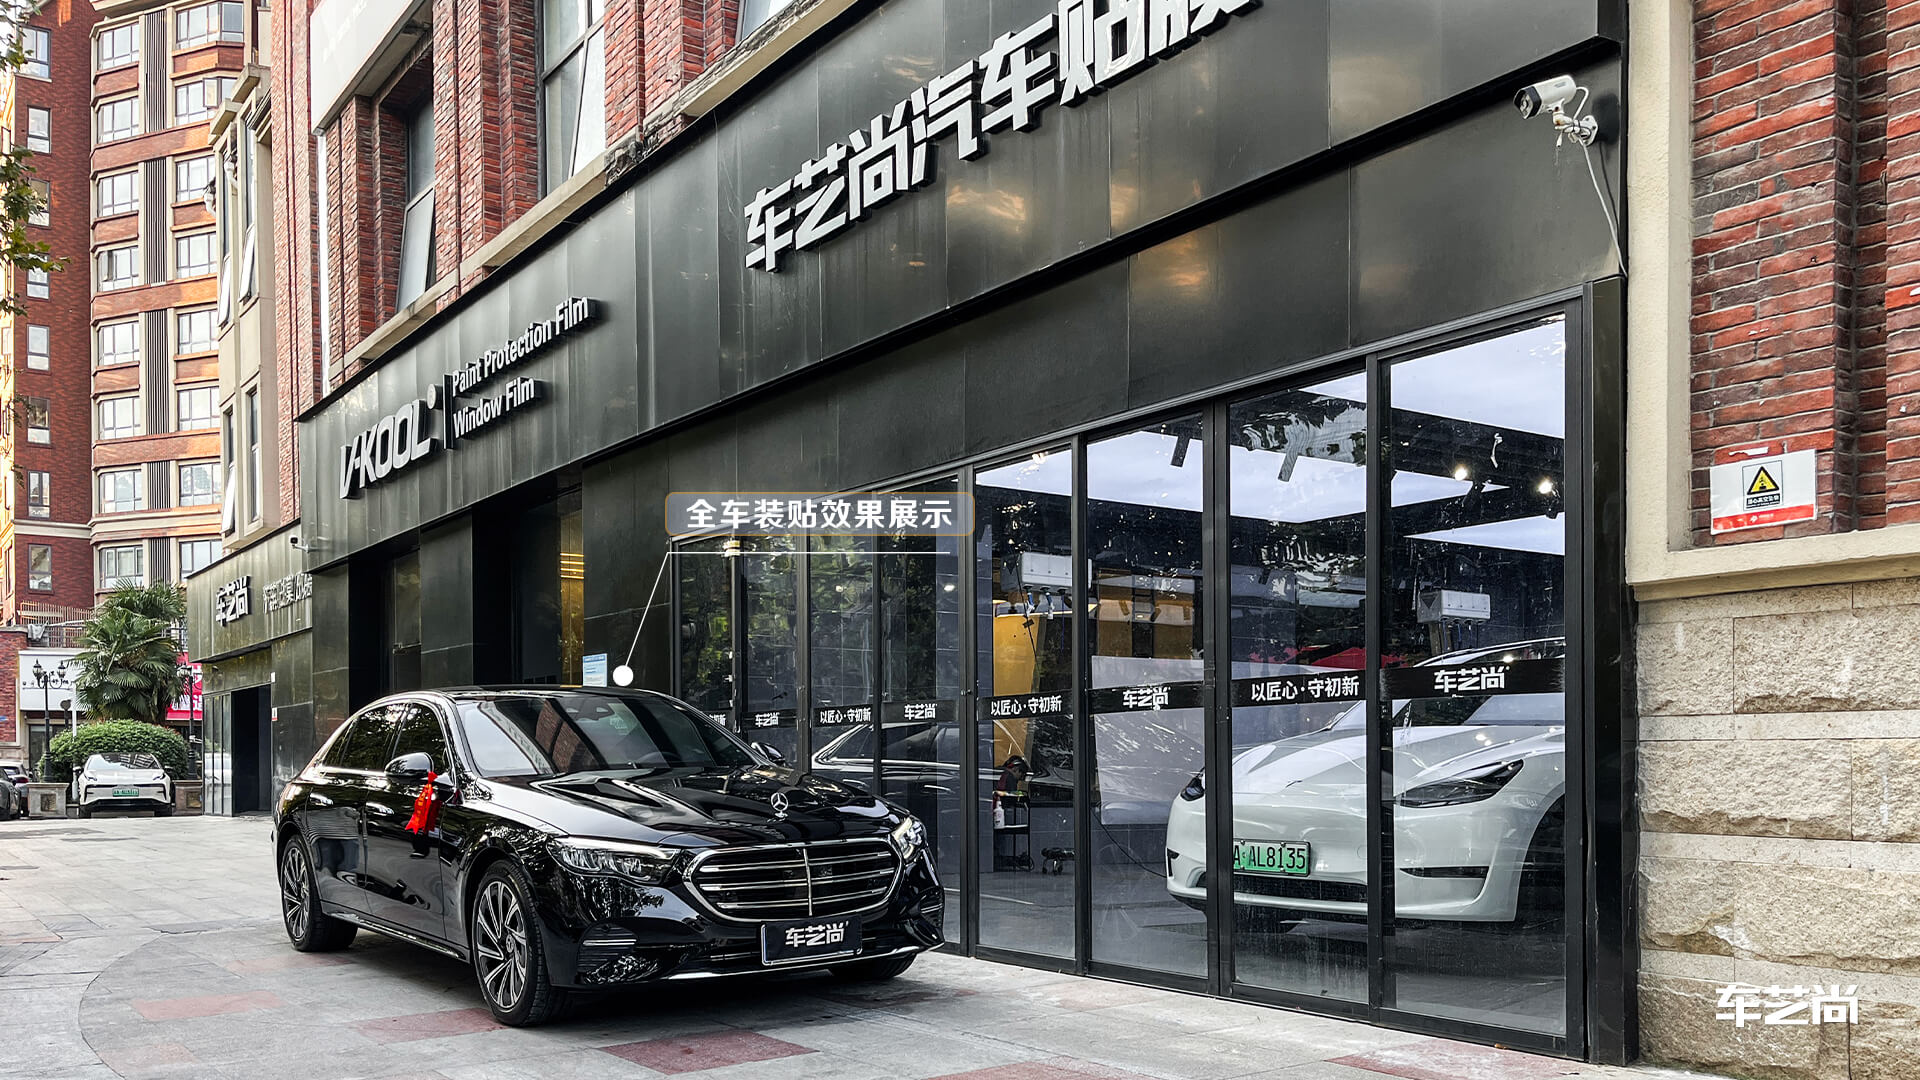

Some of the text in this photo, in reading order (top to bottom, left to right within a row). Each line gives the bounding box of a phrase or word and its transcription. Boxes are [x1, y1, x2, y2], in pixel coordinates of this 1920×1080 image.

[452, 297, 589, 397] Paint Protection Film
[453, 378, 535, 438] Window Film
[340, 399, 432, 499] V-KOOL
[1251, 675, 1360, 702] 以匠心·守初新
[1434, 665, 1508, 693] 车艺尚
[990, 694, 1062, 717] 以匠心·守初新
[1122, 686, 1170, 709] 车艺尚
[754, 712, 780, 728] 车艺尚
[904, 703, 937, 721] 车艺尚
[785, 921, 847, 947] 车艺尚
